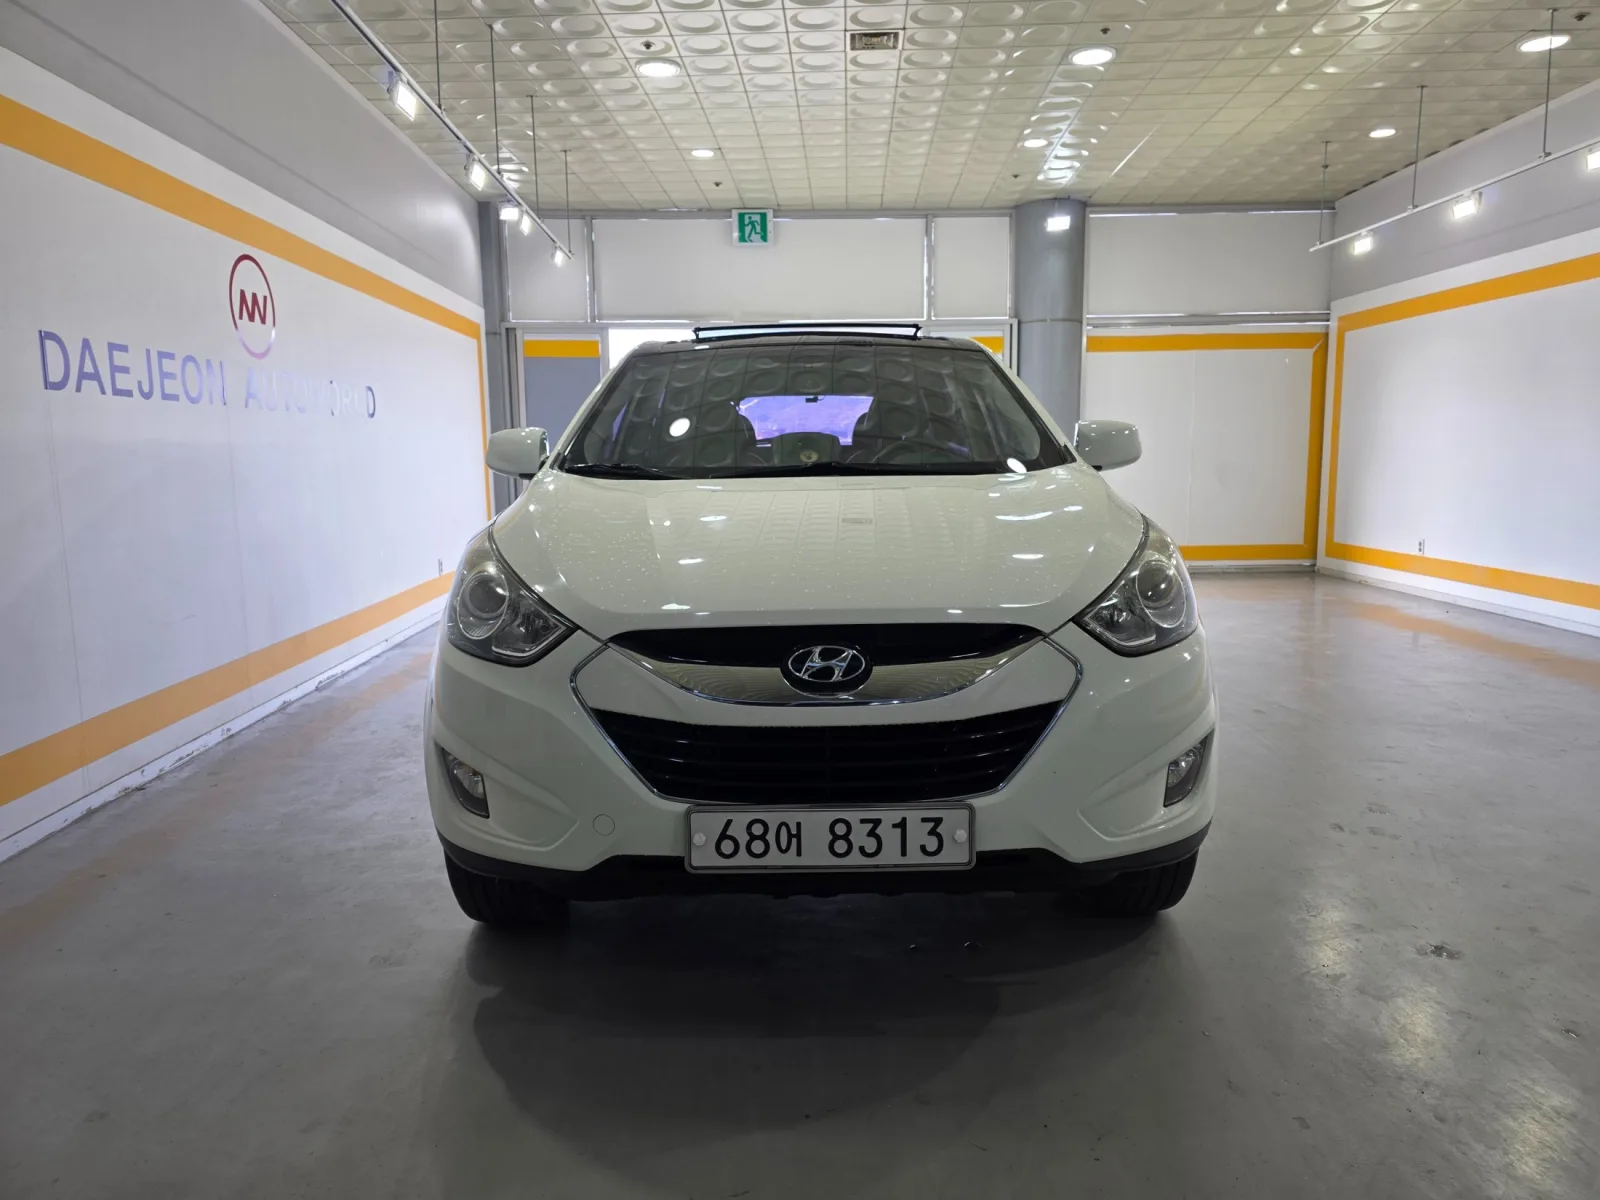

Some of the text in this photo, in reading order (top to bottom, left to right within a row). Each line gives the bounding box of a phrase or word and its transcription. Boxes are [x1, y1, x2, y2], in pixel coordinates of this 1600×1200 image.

[38, 329, 228, 406] DAEJEON
[714, 816, 944, 860] 68어 8313
